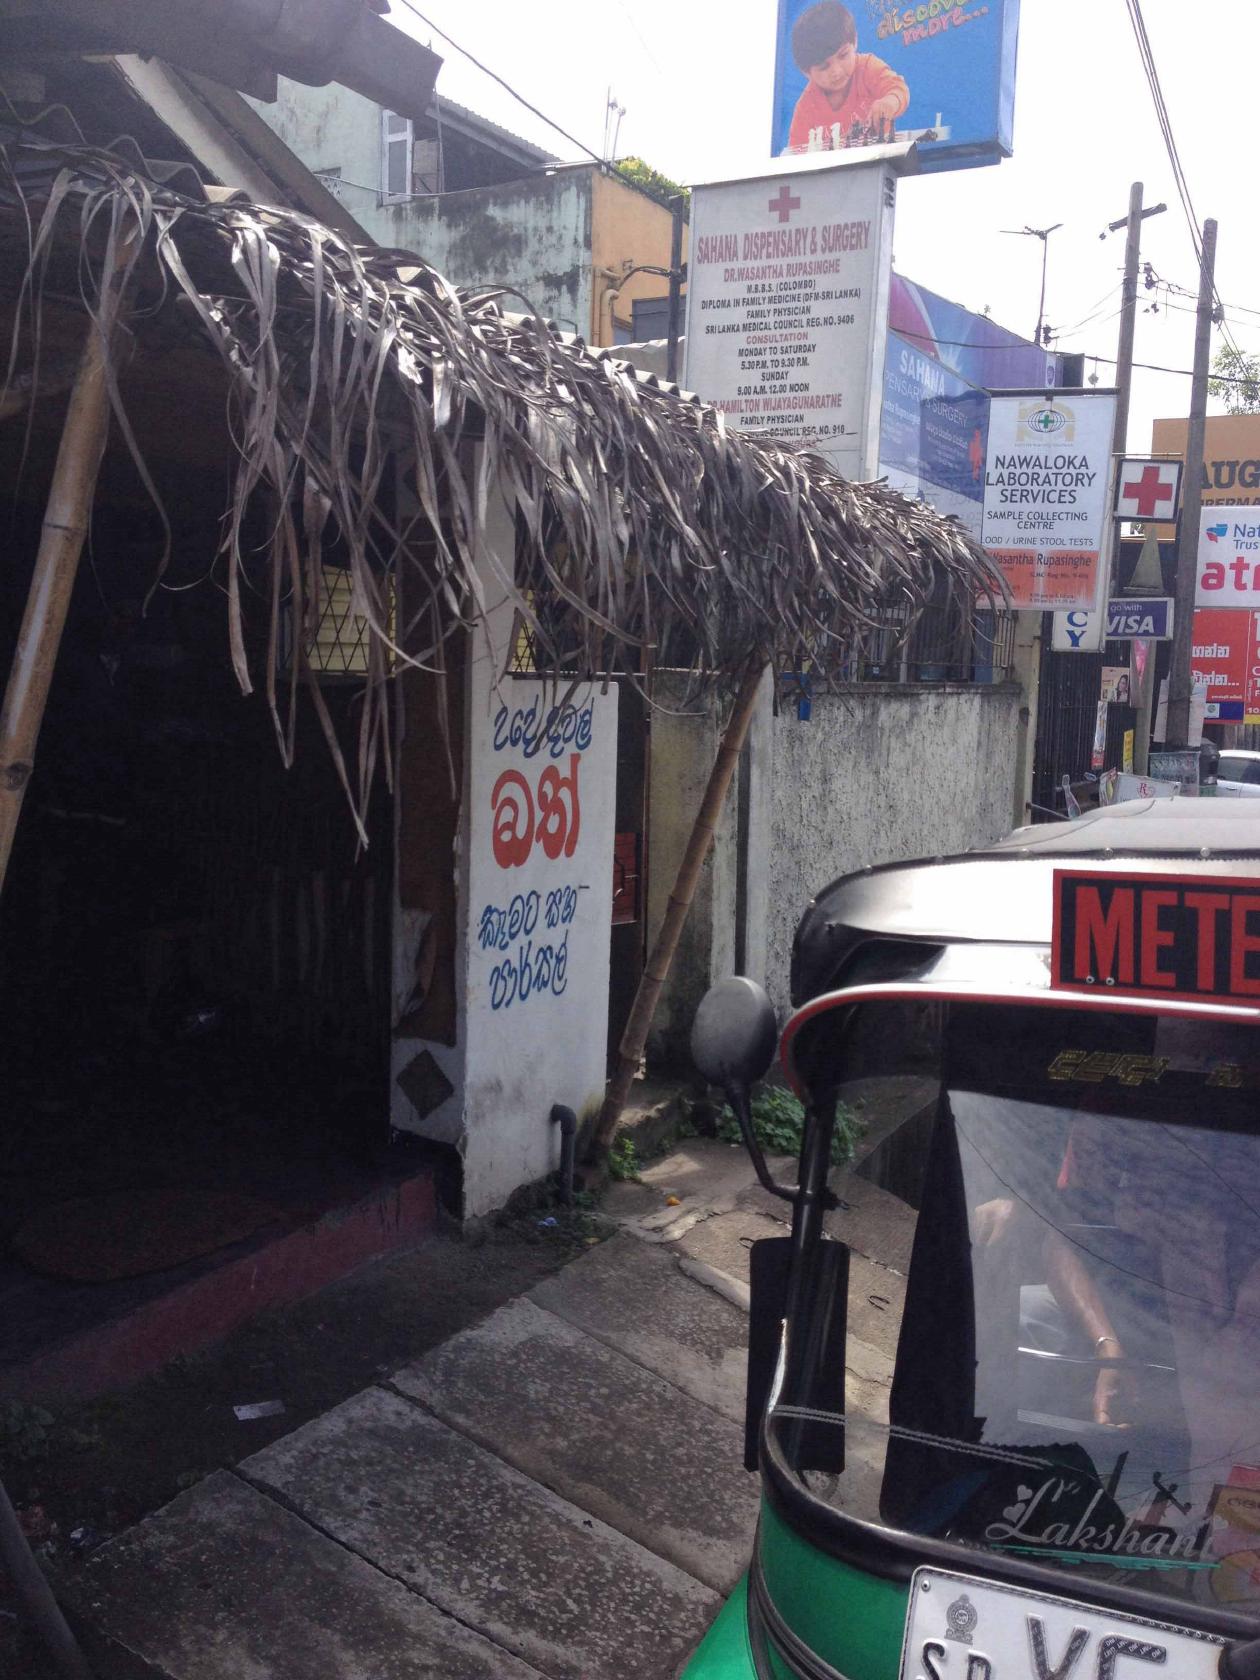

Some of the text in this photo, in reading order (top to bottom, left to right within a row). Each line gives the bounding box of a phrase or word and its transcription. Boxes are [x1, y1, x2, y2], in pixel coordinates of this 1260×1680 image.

[697, 221, 871, 265] SAHANA DISPENSARY & SURGERY
[785, 259, 841, 278] RUPASINGHE
[747, 279, 816, 294] M.B.B.S. (COLOMBO)
[701, 299, 731, 310] DIPLOMA
[733, 298, 741, 307] IN
[742, 296, 767, 307] FAMILY
[767, 293, 802, 305] MEDICINE
[746, 305, 812, 320] FAMILY PHYSICIAN
[705, 325, 717, 335] SRI
[717, 323, 740, 334] LANKA
[742, 321, 772, 332] MEDICAL
[773, 319, 805, 331] COUNCIL
[746, 331, 809, 345] CONSULTATION
[738, 344, 817, 358] MONDAY TO SATURDAY
[770, 359, 779, 368] TO
[761, 371, 789, 382] SUNDAY
[900, 350, 946, 397] SAHANA
[769, 384, 787, 394] 12.00
[789, 383, 810, 393] NOON
[740, 414, 804, 426] FAMILY PHYSICIAN
[932, 399, 968, 429] SURGERY
[995, 455, 1089, 470] NAWALOKA
[985, 472, 1097, 487] LABORATORY
[999, 488, 1077, 504] SERVICES
[987, 510, 1088, 521] SAMPLE COLLECTING
[1017, 521, 1055, 530] CENTRE
[1013, 537, 1037, 545] URINE
[1040, 537, 1066, 546] STOOL
[1069, 538, 1094, 546] TESTS
[1036, 553, 1092, 569] Rupasinghe
[1106, 615, 1155, 634] VISA
[1074, 886, 1260, 993] METE
